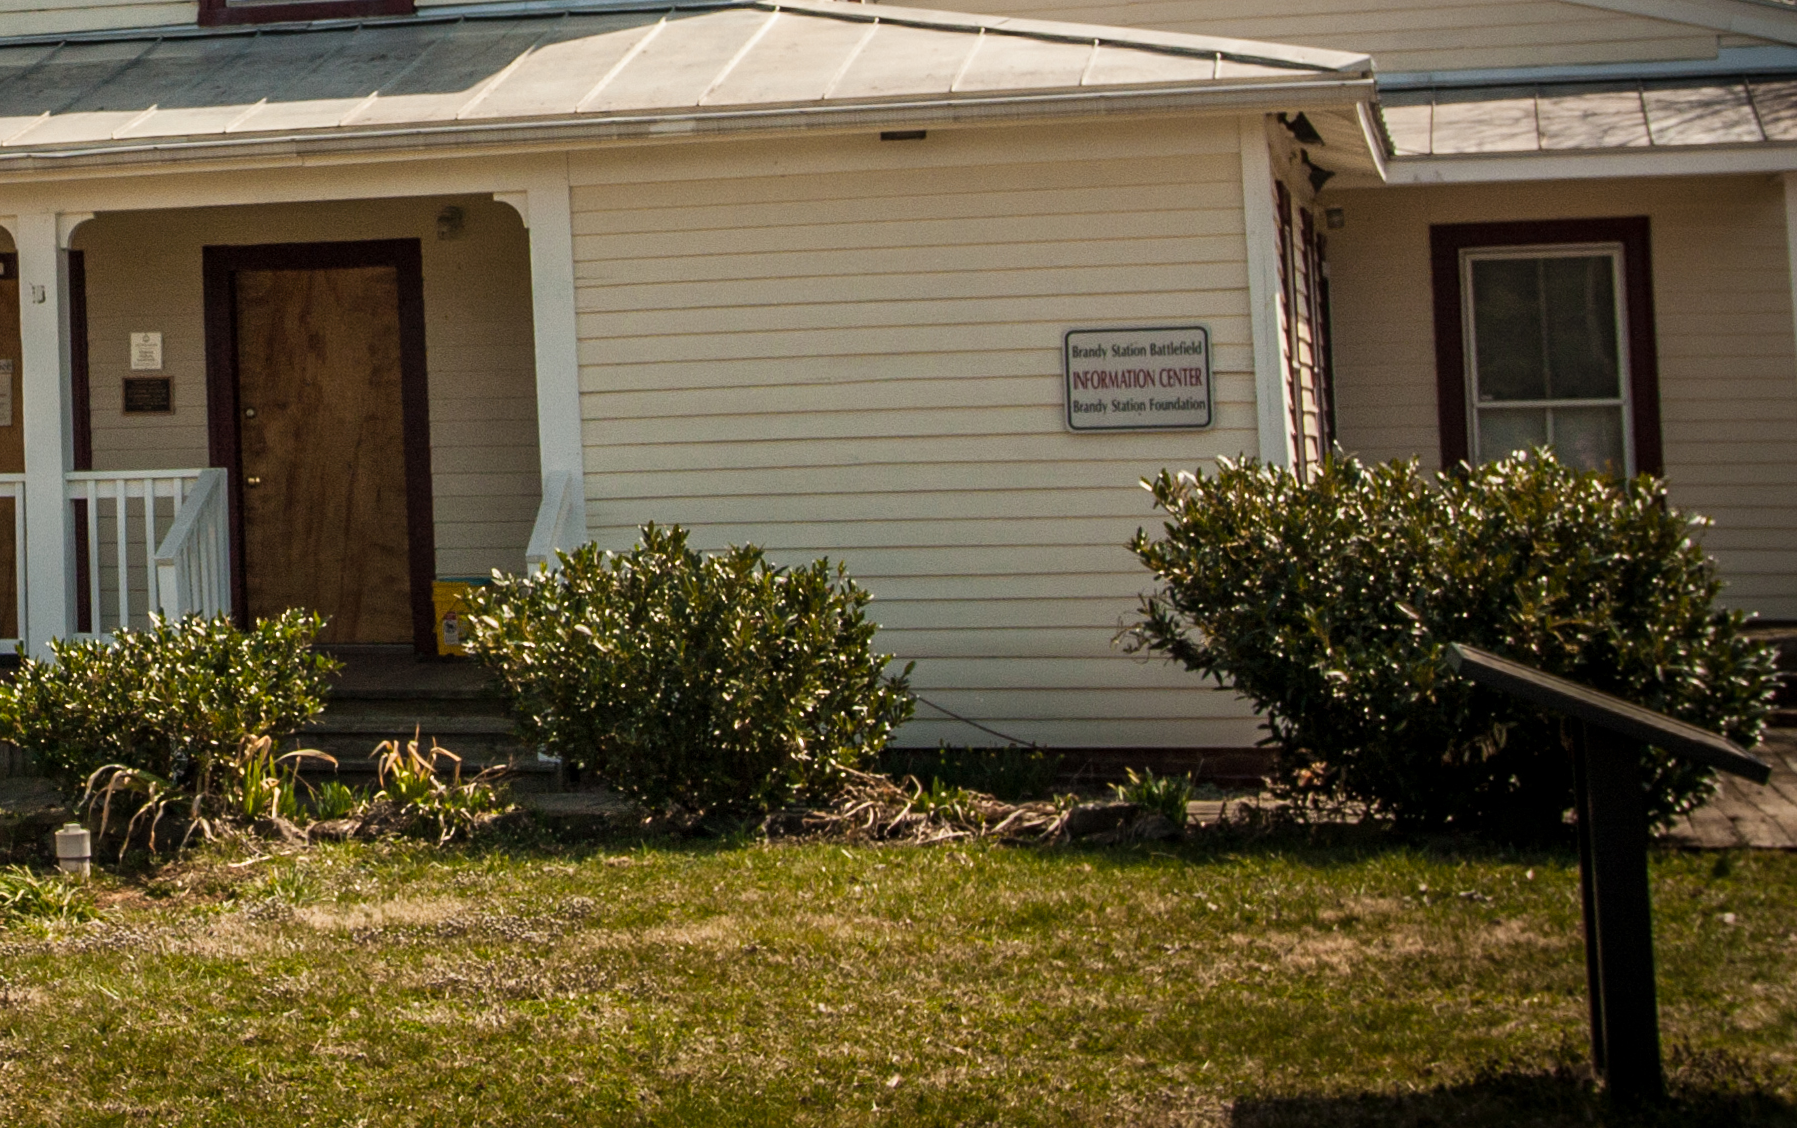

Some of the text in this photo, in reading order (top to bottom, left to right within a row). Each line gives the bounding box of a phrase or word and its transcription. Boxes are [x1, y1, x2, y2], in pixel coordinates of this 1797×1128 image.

[1072, 341, 1202, 360] Brandy Station Battlefield
[1073, 367, 1203, 390] INFORMATION CENTER
[1073, 396, 1205, 414] Brandy Station Foundation
